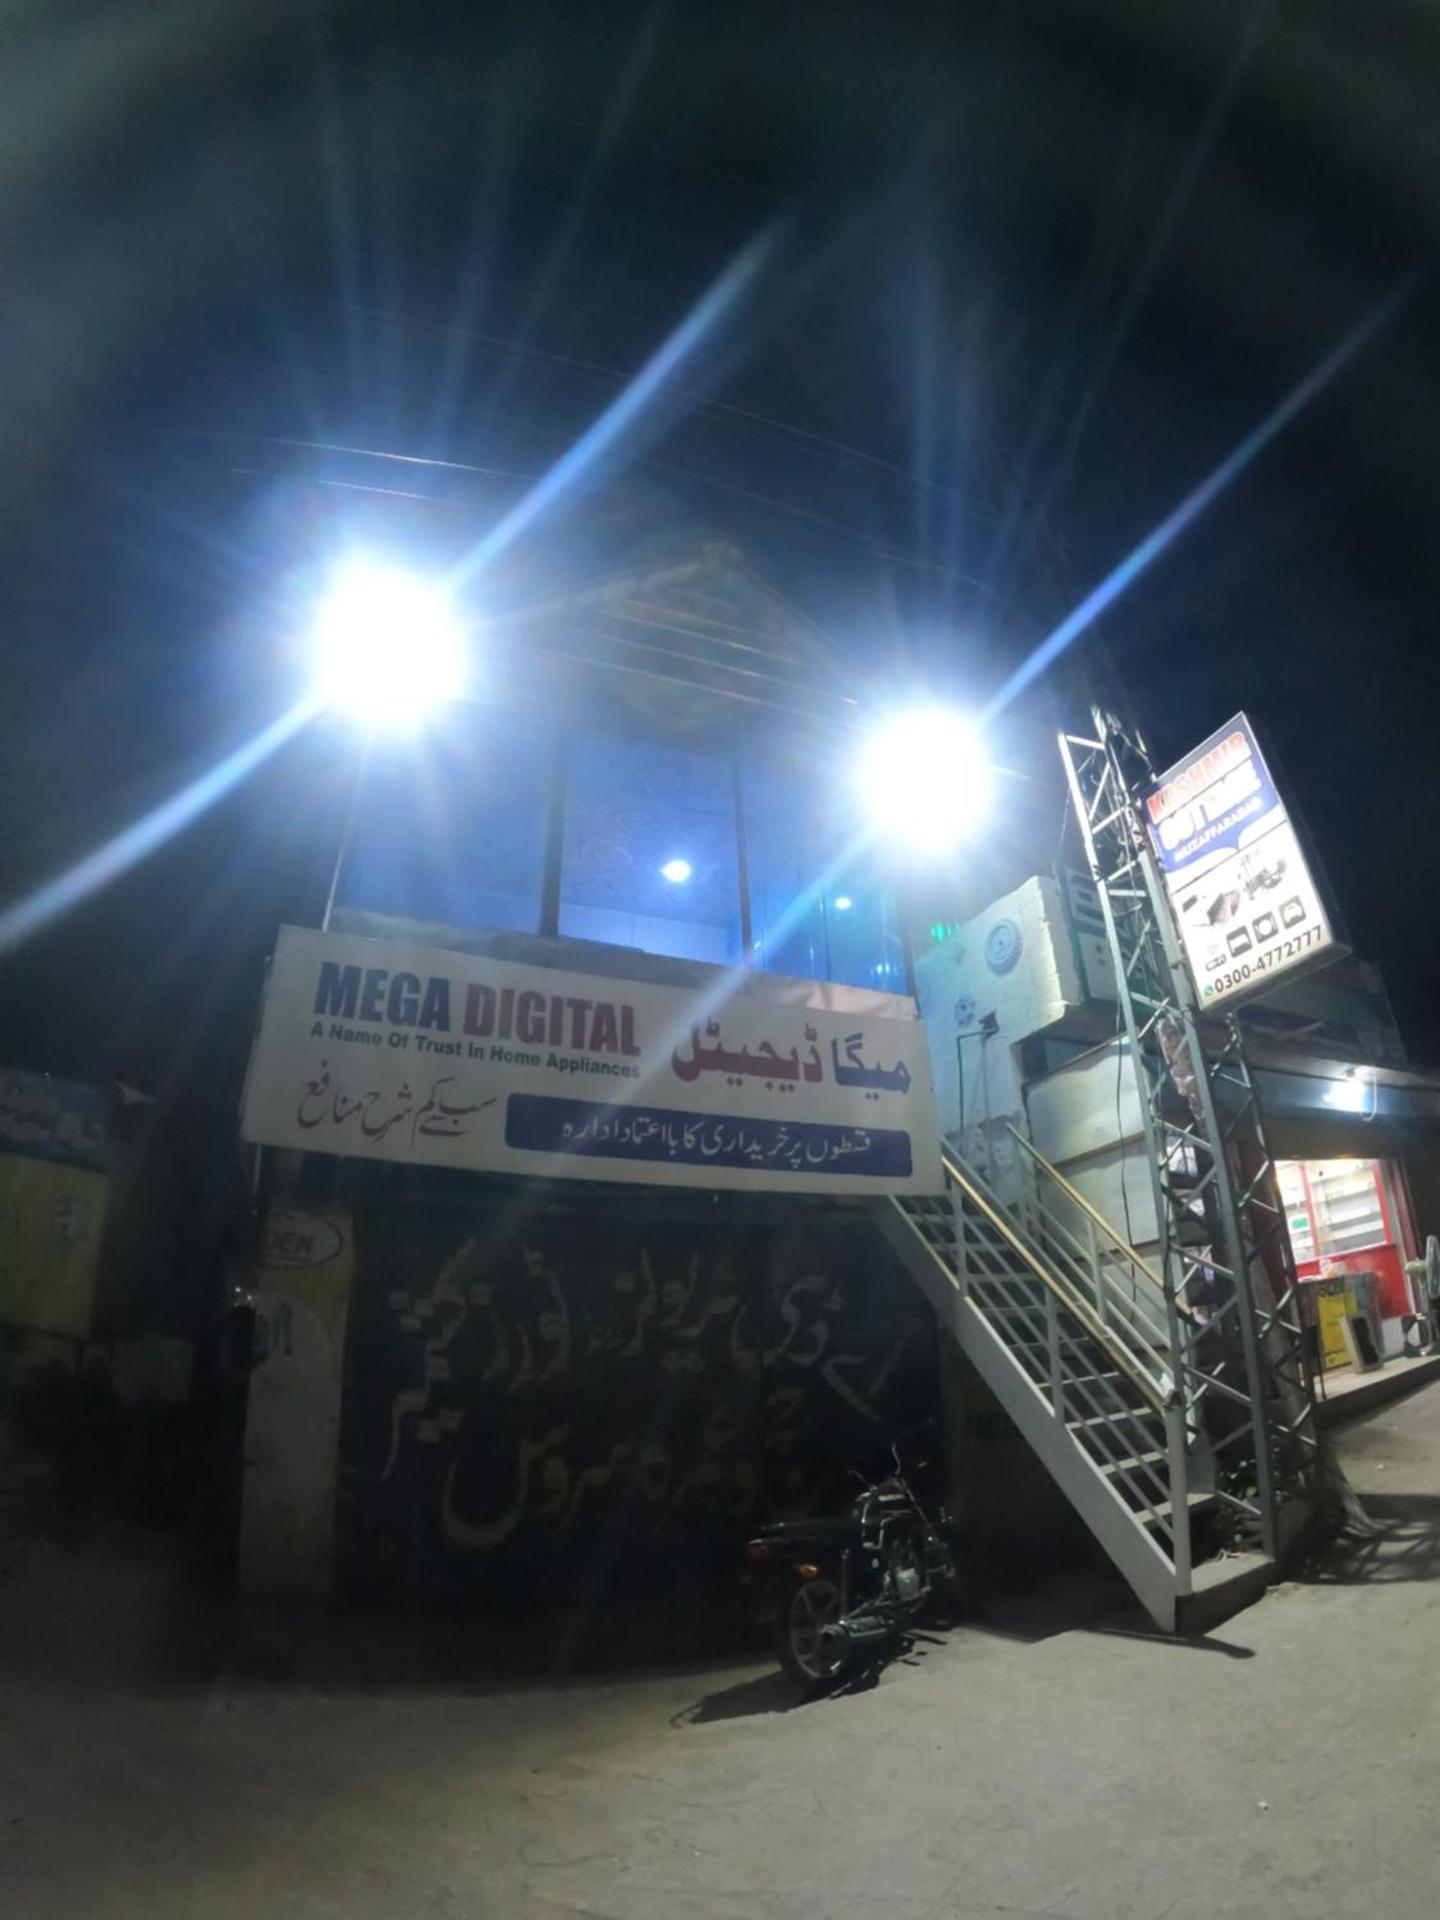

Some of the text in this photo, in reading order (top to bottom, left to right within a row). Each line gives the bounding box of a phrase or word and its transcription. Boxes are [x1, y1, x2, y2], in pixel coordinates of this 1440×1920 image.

[1213, 925, 1323, 994] 0300-4772777
[313, 960, 641, 1057] MEGA DIGITAL
[310, 1021, 641, 1080] A Name Of Trust In Home Appliances
[670, 1020, 912, 1100] میگا ڈیجیٹل
[296, 1059, 365, 1130] منافع
[361, 1081, 414, 1145] شرح
[683, 1119, 706, 1150] کا
[700, 1123, 790, 1162] خریداری
[784, 1140, 802, 1170] پر
[805, 1129, 872, 1164] قسطوں
